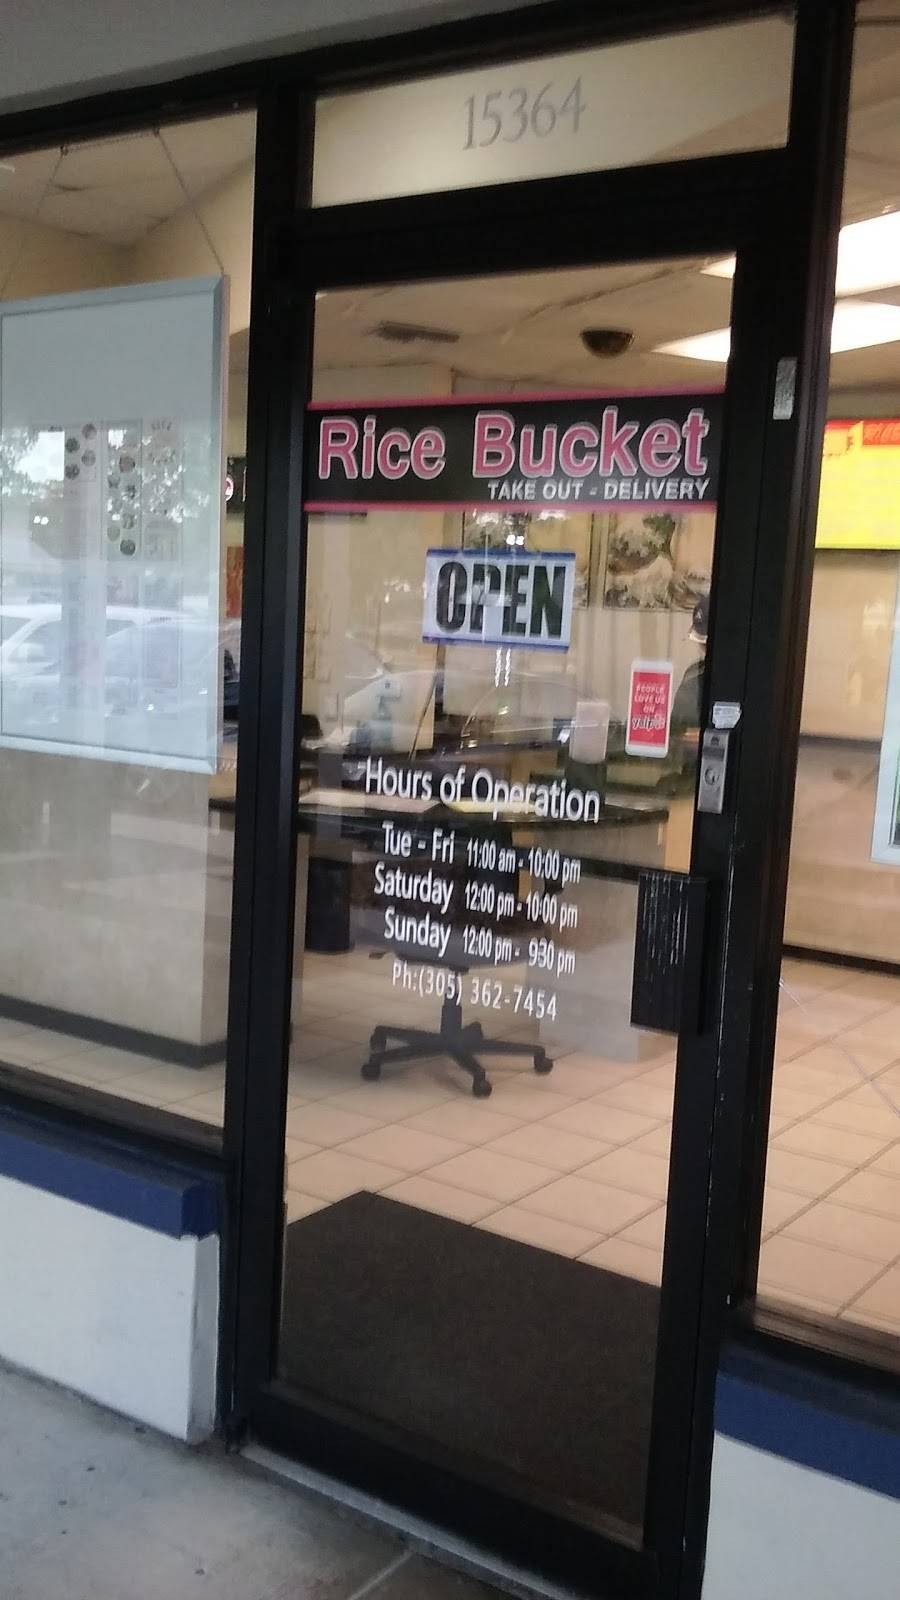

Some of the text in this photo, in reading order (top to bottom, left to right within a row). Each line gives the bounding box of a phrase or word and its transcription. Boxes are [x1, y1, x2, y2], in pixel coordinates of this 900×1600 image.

[462, 75, 587, 150] 15364
[318, 405, 710, 480] Rice Bucket
[487, 479, 535, 500] TAKE
[543, 479, 584, 500] OUT
[604, 478, 710, 500] DELIVERY
[436, 561, 566, 638] OPEN
[634, 694, 654, 703] LOVE
[635, 684, 665, 695] PEOPLE
[364, 756, 600, 823] Hours of Operation
[382, 821, 411, 858] Tue
[431, 828, 455, 864] Fri
[467, 838, 496, 872] 11:00
[499, 850, 516, 874] am
[528, 847, 560, 882] 10:00
[562, 857, 581, 887] pm
[374, 861, 453, 914] Saturday
[465, 880, 494, 915] 12:00
[497, 890, 514, 921] pm
[526, 890, 557, 925] 10:00
[559, 902, 578, 932] pm
[384, 905, 451, 957] Sunday
[463, 924, 492, 958] 12:00
[494, 935, 512, 965] pm
[557, 948, 576, 978] pm
[470, 977, 557, 1021] 362-7454
